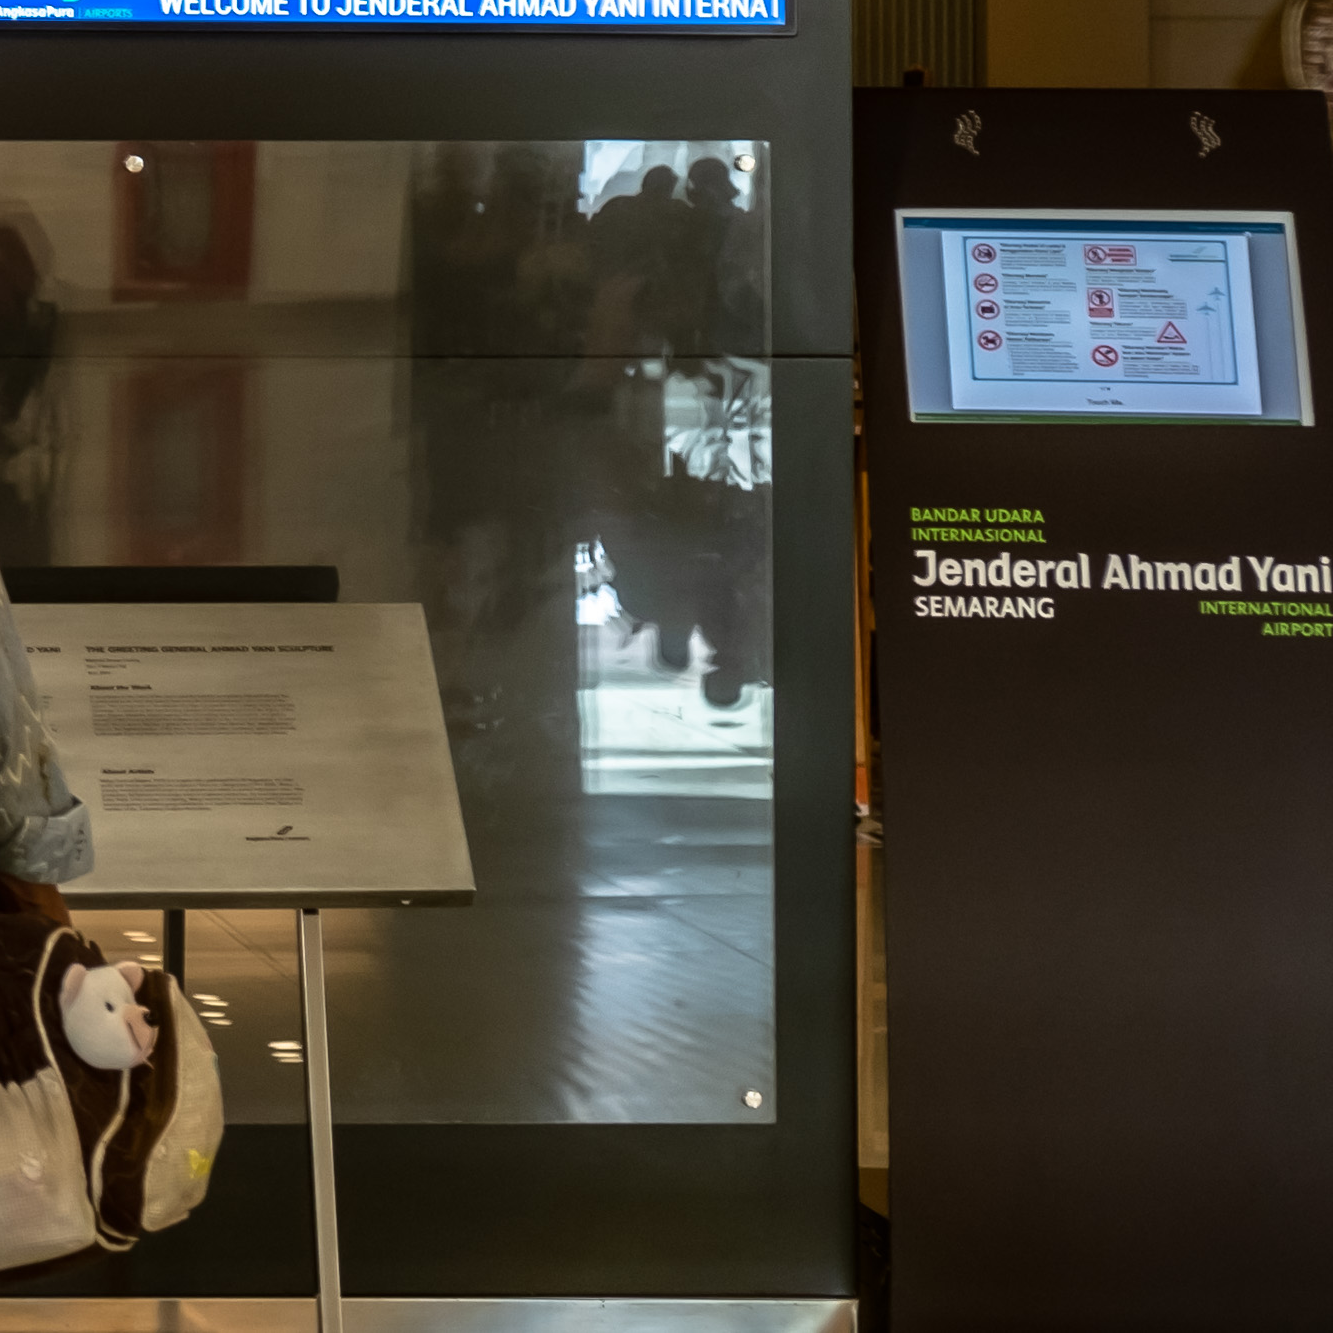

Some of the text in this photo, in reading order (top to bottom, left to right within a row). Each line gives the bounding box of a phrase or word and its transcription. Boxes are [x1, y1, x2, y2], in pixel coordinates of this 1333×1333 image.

[911, 507, 1046, 523] BANDAR UDARA
[911, 527, 1047, 544] INTERNASIONAL
[913, 549, 1333, 594] Jenderal Ahmad Yani
[914, 595, 1055, 619] SEMARANG
[1199, 600, 1333, 617] INTERNATIONAL
[1262, 622, 1333, 637] AIRPORT
